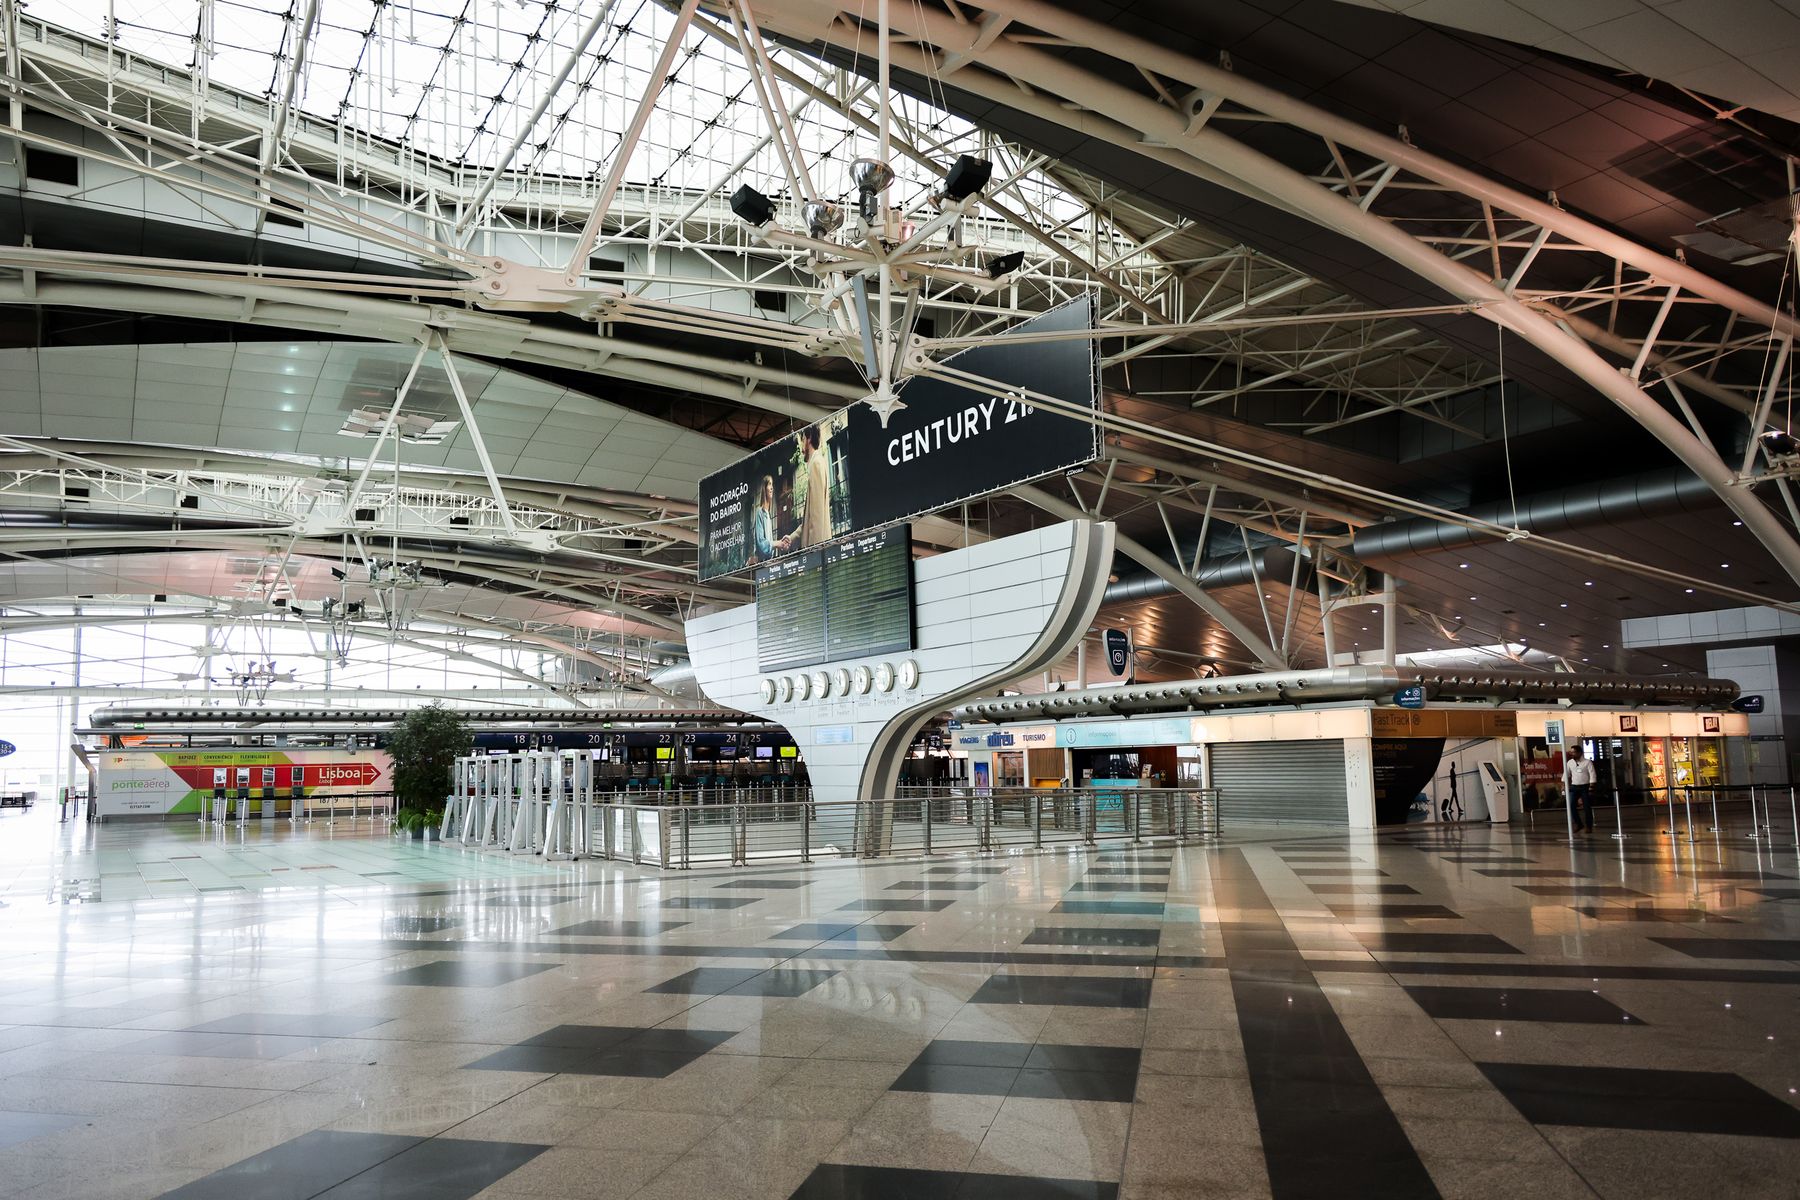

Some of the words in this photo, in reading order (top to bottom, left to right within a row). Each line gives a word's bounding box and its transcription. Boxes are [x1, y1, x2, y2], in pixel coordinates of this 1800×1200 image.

[887, 397, 997, 466] CENTURY
[710, 496, 719, 508] NO
[720, 482, 749, 504] CORAÇÃO
[710, 511, 719, 523] DO
[720, 502, 742, 519] BAIRRO
[710, 529, 722, 540] PARA
[722, 522, 742, 536] MELHOR
[710, 544, 715, 553] O
[715, 534, 745, 551] ACONSELHAR
[514, 735, 526, 744] 18
[541, 735, 554, 744] 19
[588, 735, 600, 743] 20
[615, 735, 626, 743] 21
[659, 735, 671, 743] 22
[684, 734, 696, 743] 23
[726, 734, 737, 743] 24
[750, 734, 761, 743] 25
[1022, 734, 1046, 742] TURISMO
[319, 767, 360, 779] Lisboa
